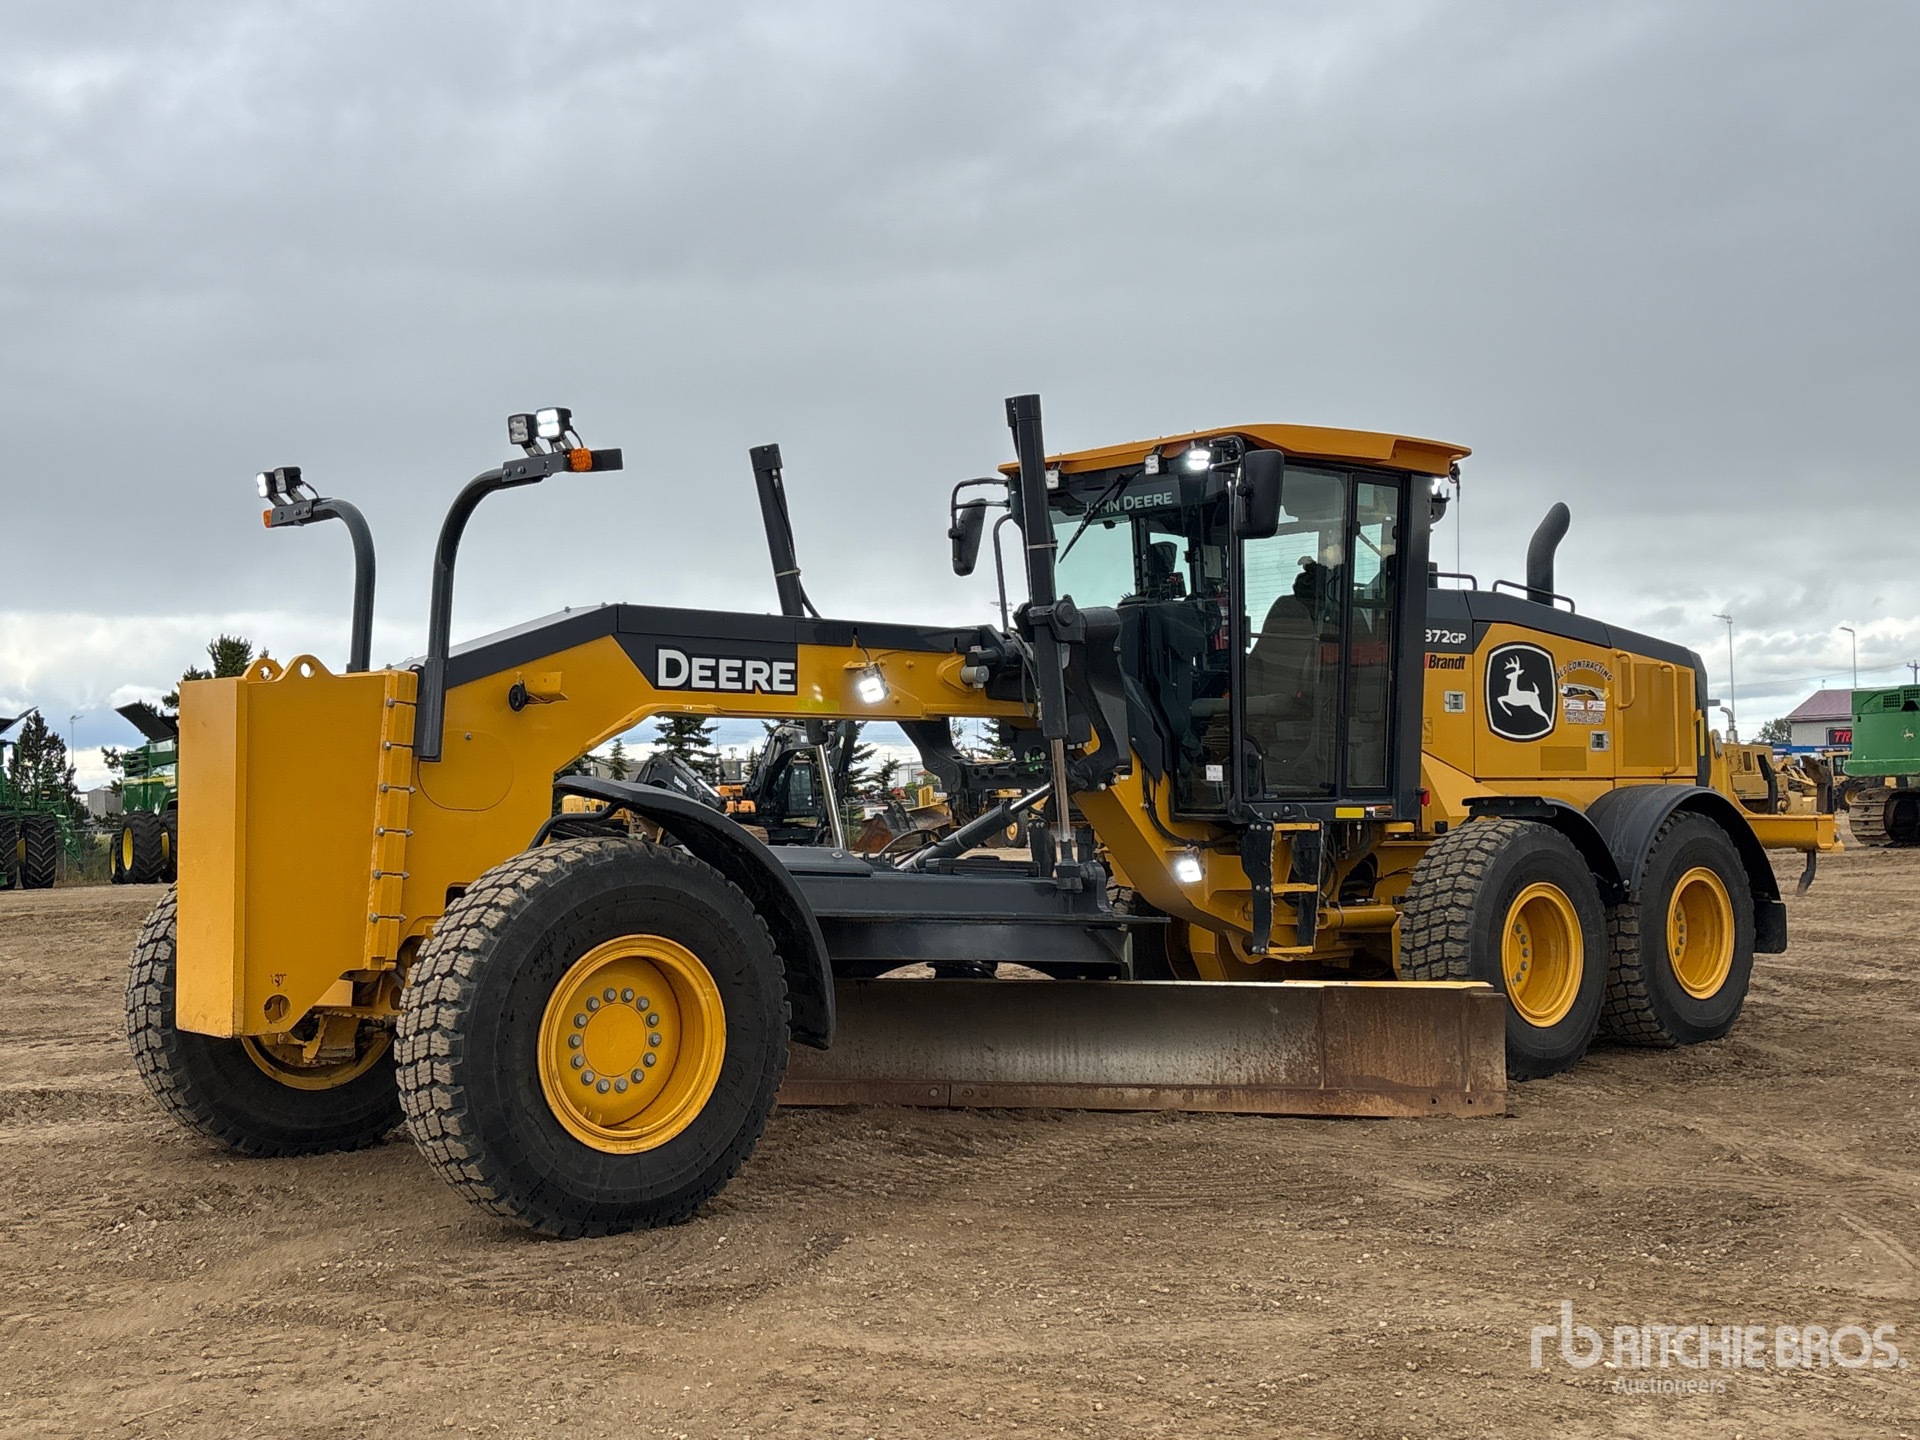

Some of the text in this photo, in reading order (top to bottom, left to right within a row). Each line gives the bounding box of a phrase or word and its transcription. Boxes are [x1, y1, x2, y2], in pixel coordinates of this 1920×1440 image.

[1123, 492, 1173, 511] DEERE
[657, 648, 796, 692] DEERE
[1428, 655, 1466, 669] Brandt
[1834, 731, 1852, 743] TR
